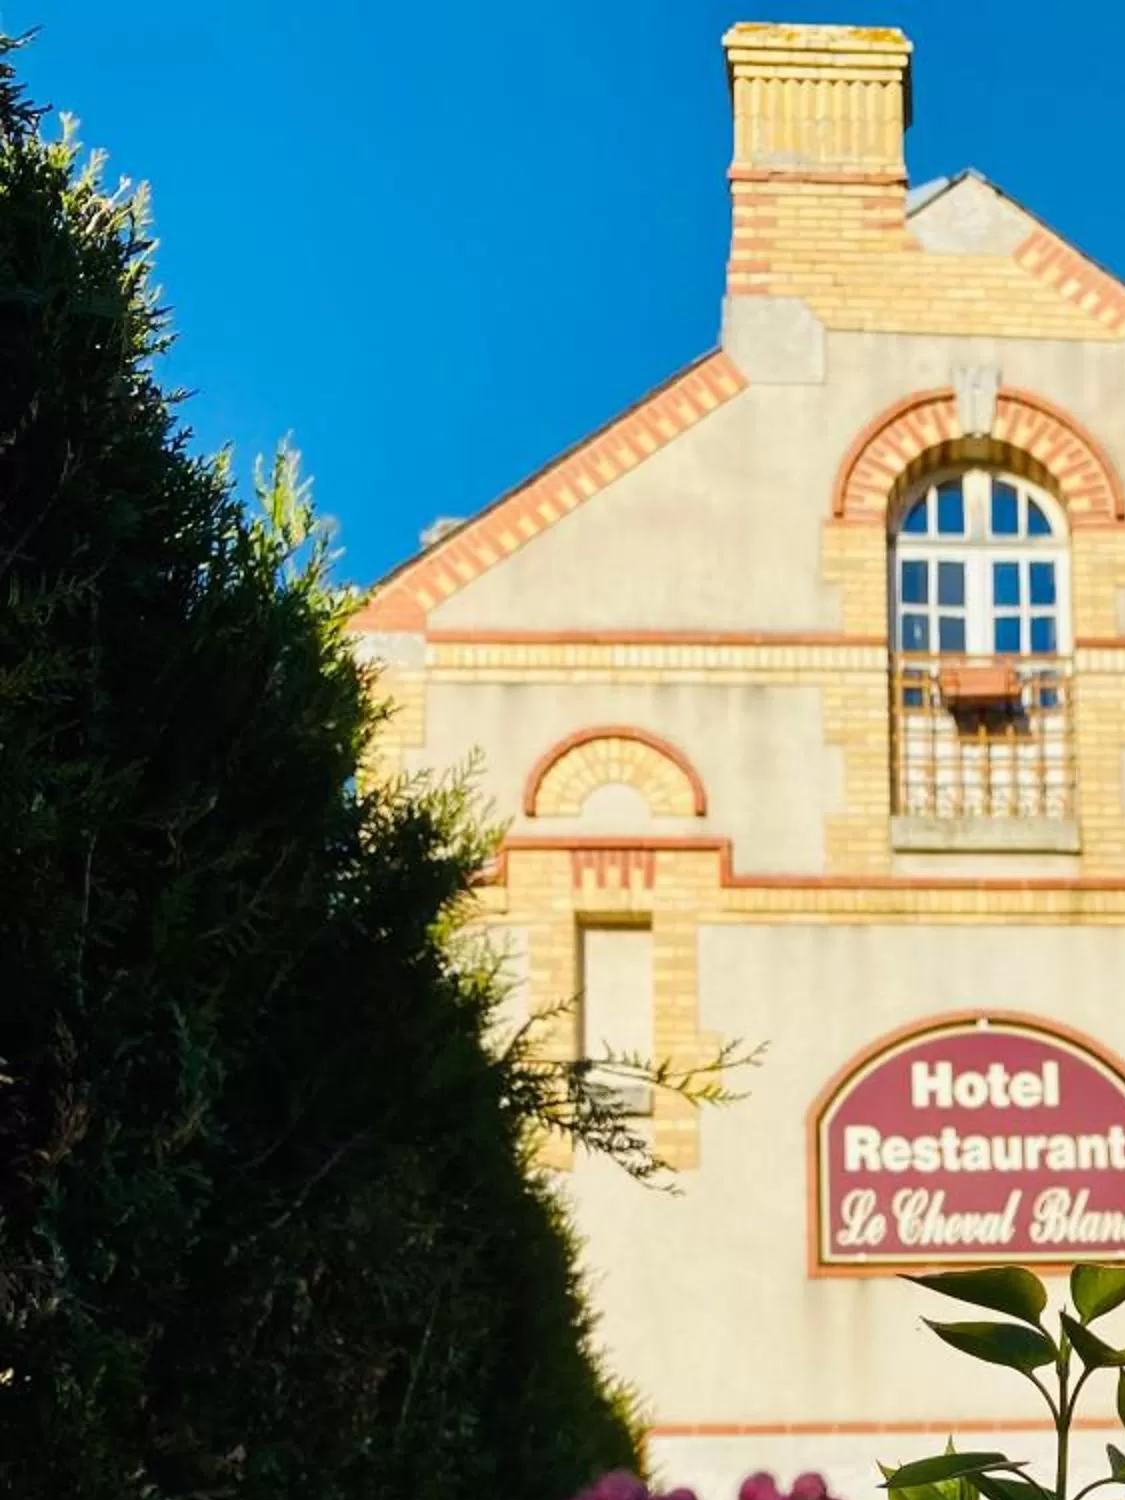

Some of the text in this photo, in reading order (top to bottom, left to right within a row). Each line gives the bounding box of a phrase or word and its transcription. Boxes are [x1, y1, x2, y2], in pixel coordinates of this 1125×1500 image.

[911, 1060, 1060, 1108] Hotel
[836, 1188, 887, 1247] Le
[891, 1187, 1022, 1246] Cheval
